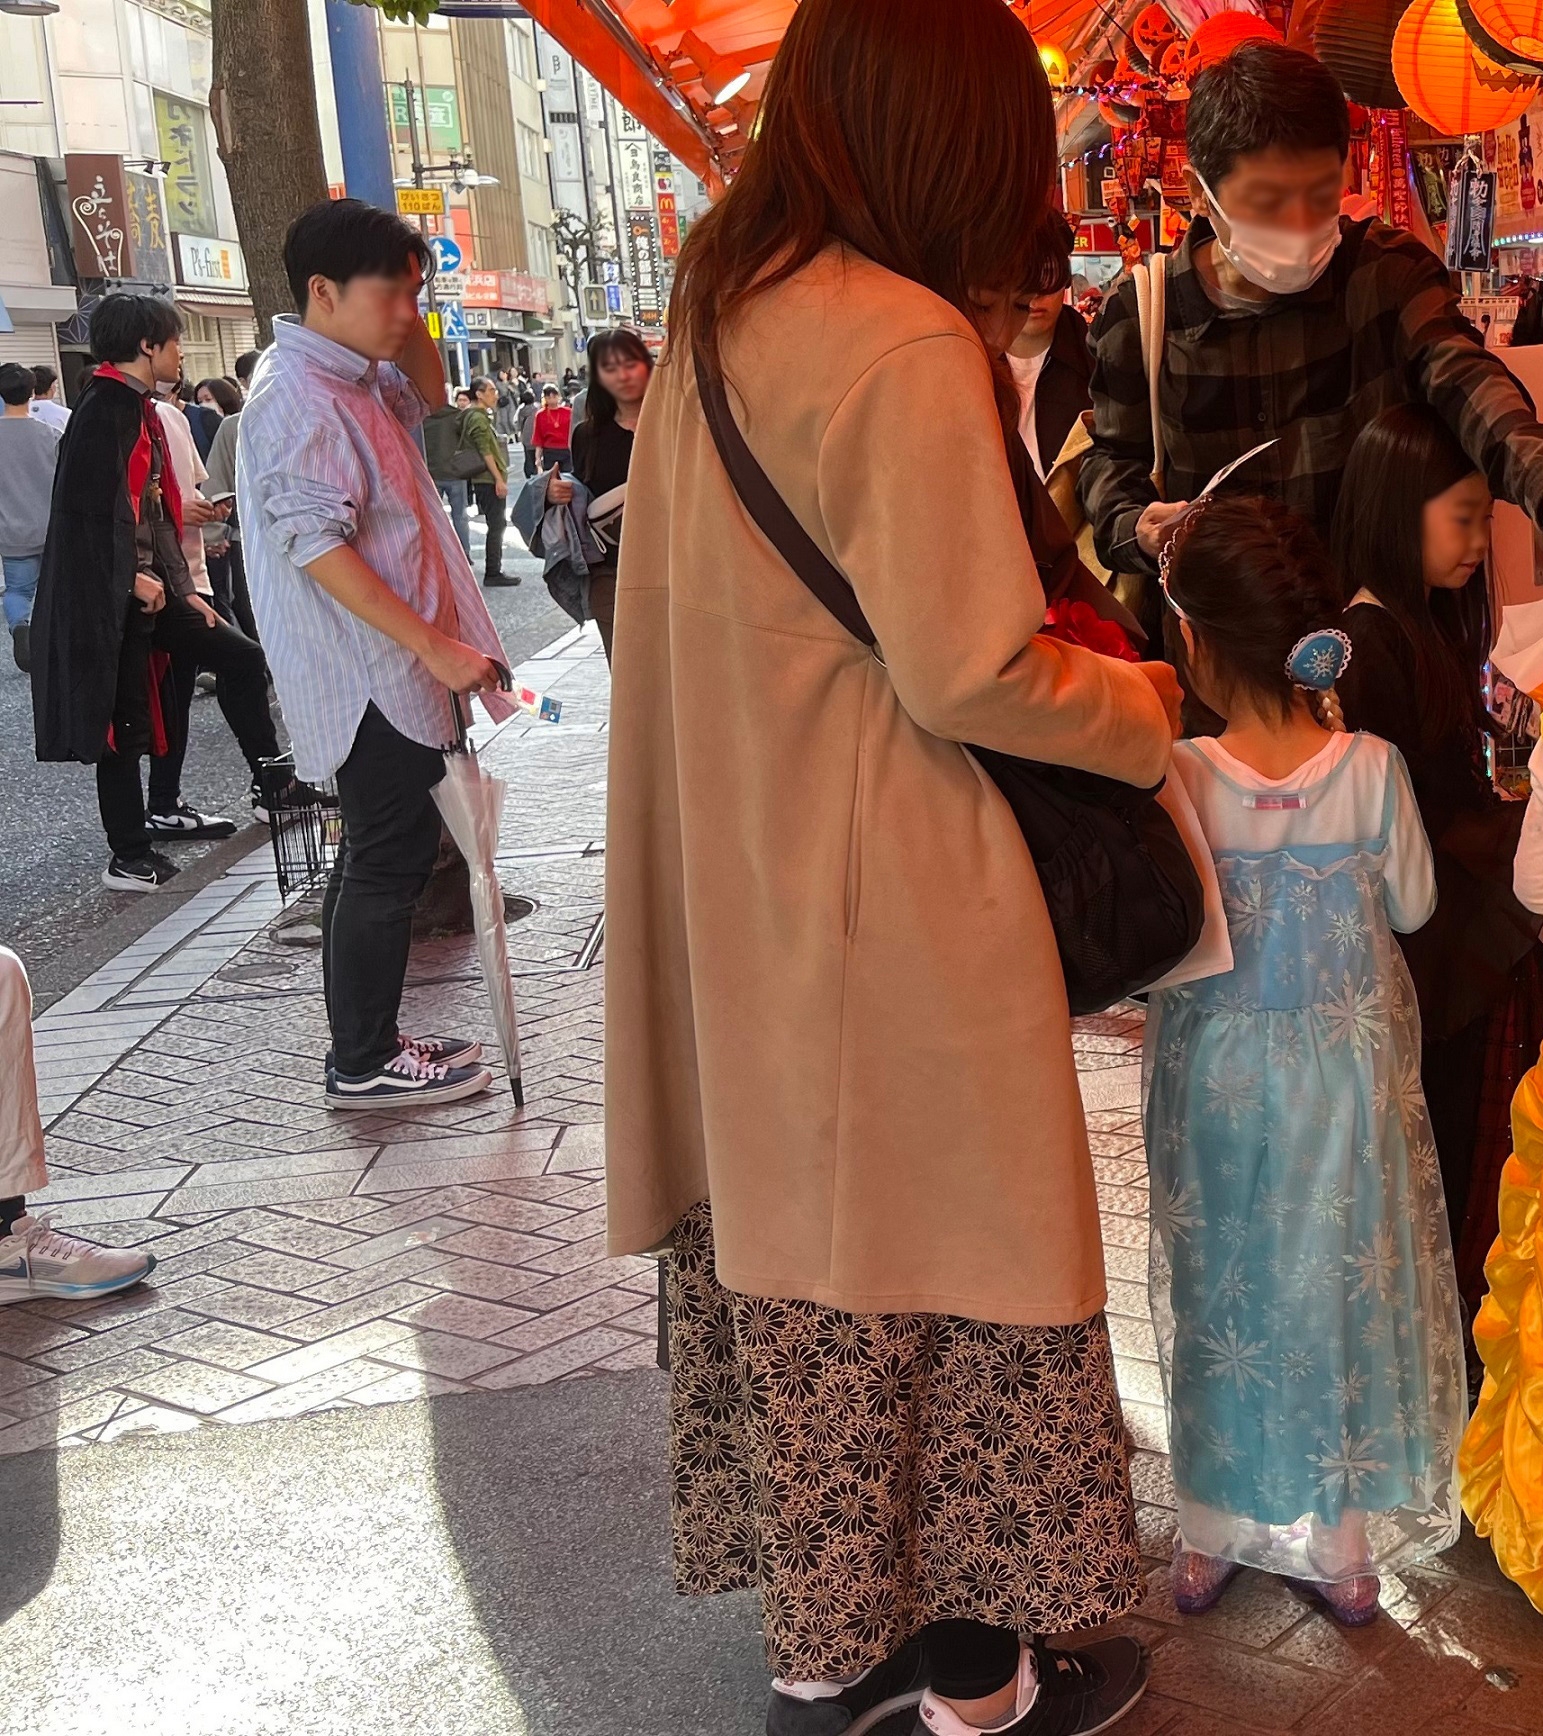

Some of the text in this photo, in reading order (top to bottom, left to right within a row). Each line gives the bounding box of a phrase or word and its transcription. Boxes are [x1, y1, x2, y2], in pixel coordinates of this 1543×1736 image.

[400, 192, 440, 201] けいさつ
[401, 201, 442, 211] 110ばん
[635, 235, 653, 287] 俺の部屋
